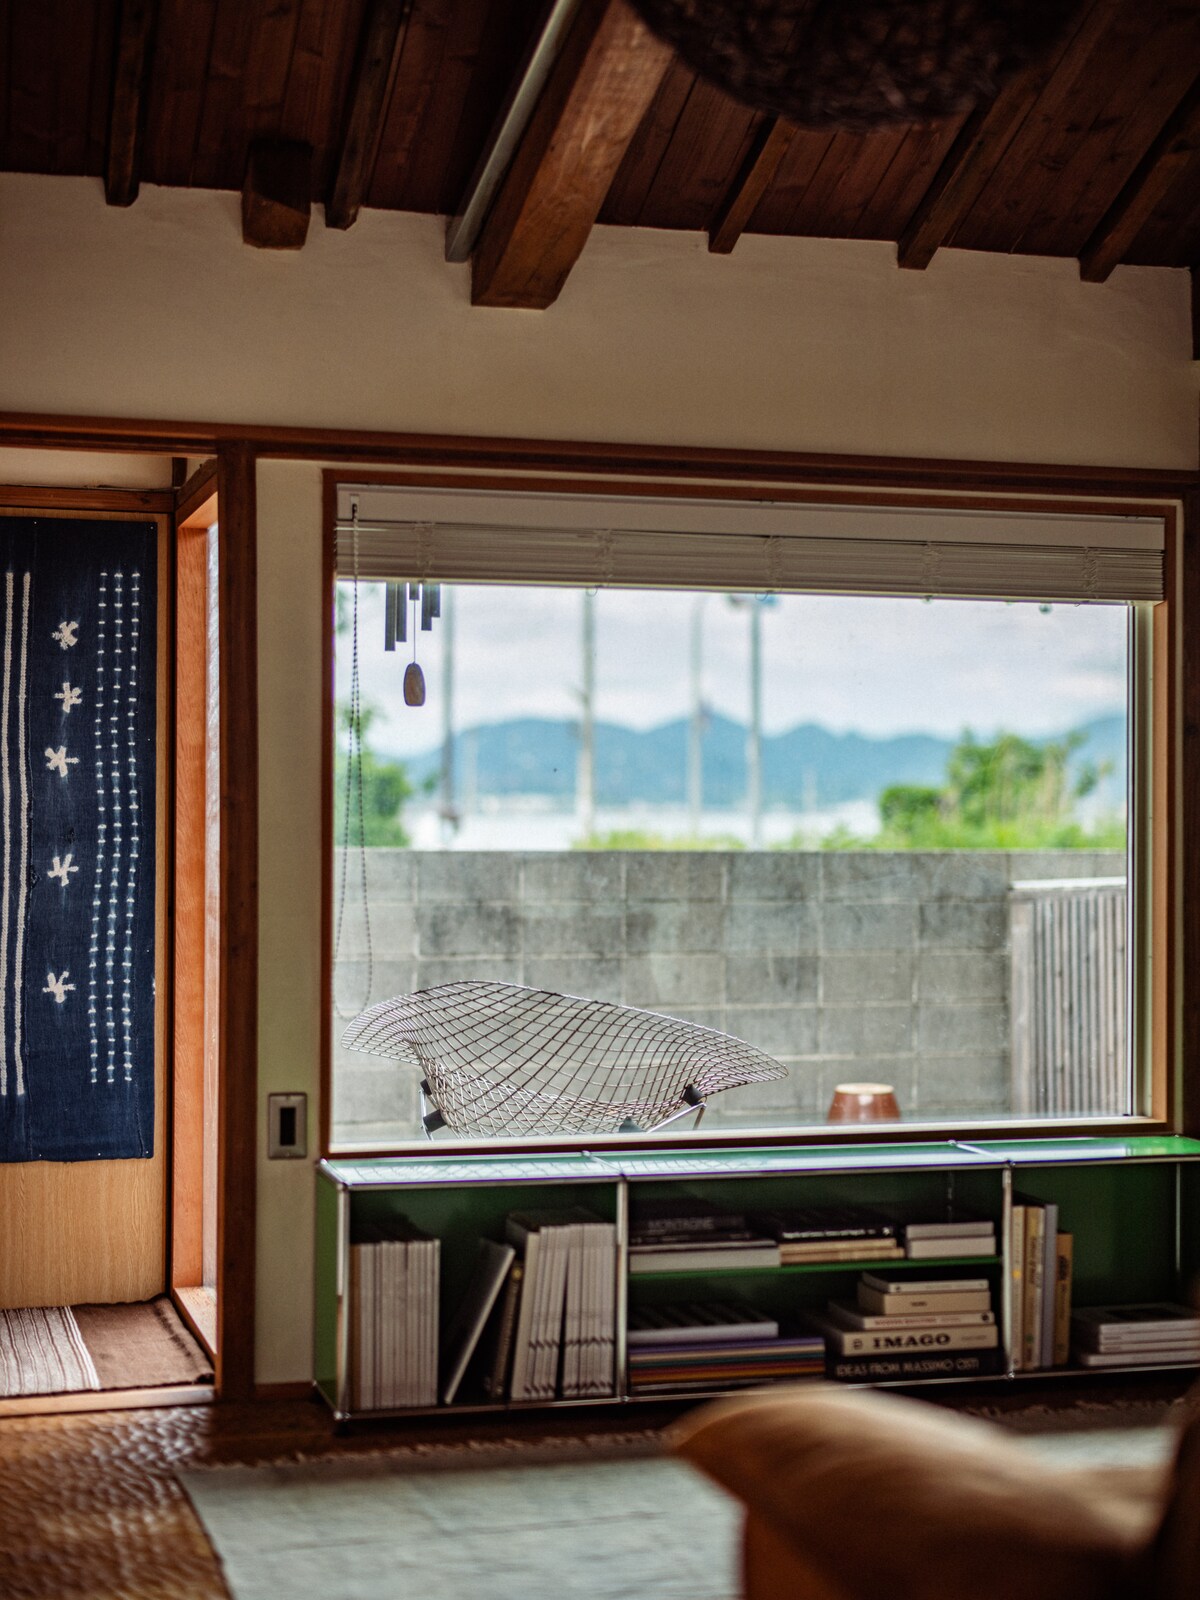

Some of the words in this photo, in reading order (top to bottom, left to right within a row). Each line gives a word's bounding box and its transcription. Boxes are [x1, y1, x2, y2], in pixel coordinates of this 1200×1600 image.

[872, 1333, 951, 1350] IMAGO
[836, 1363, 868, 1378] IDEAS
[869, 1361, 901, 1376] FROM
[903, 1358, 954, 1374] MASSIMO
[955, 1357, 980, 1371] OSTI
